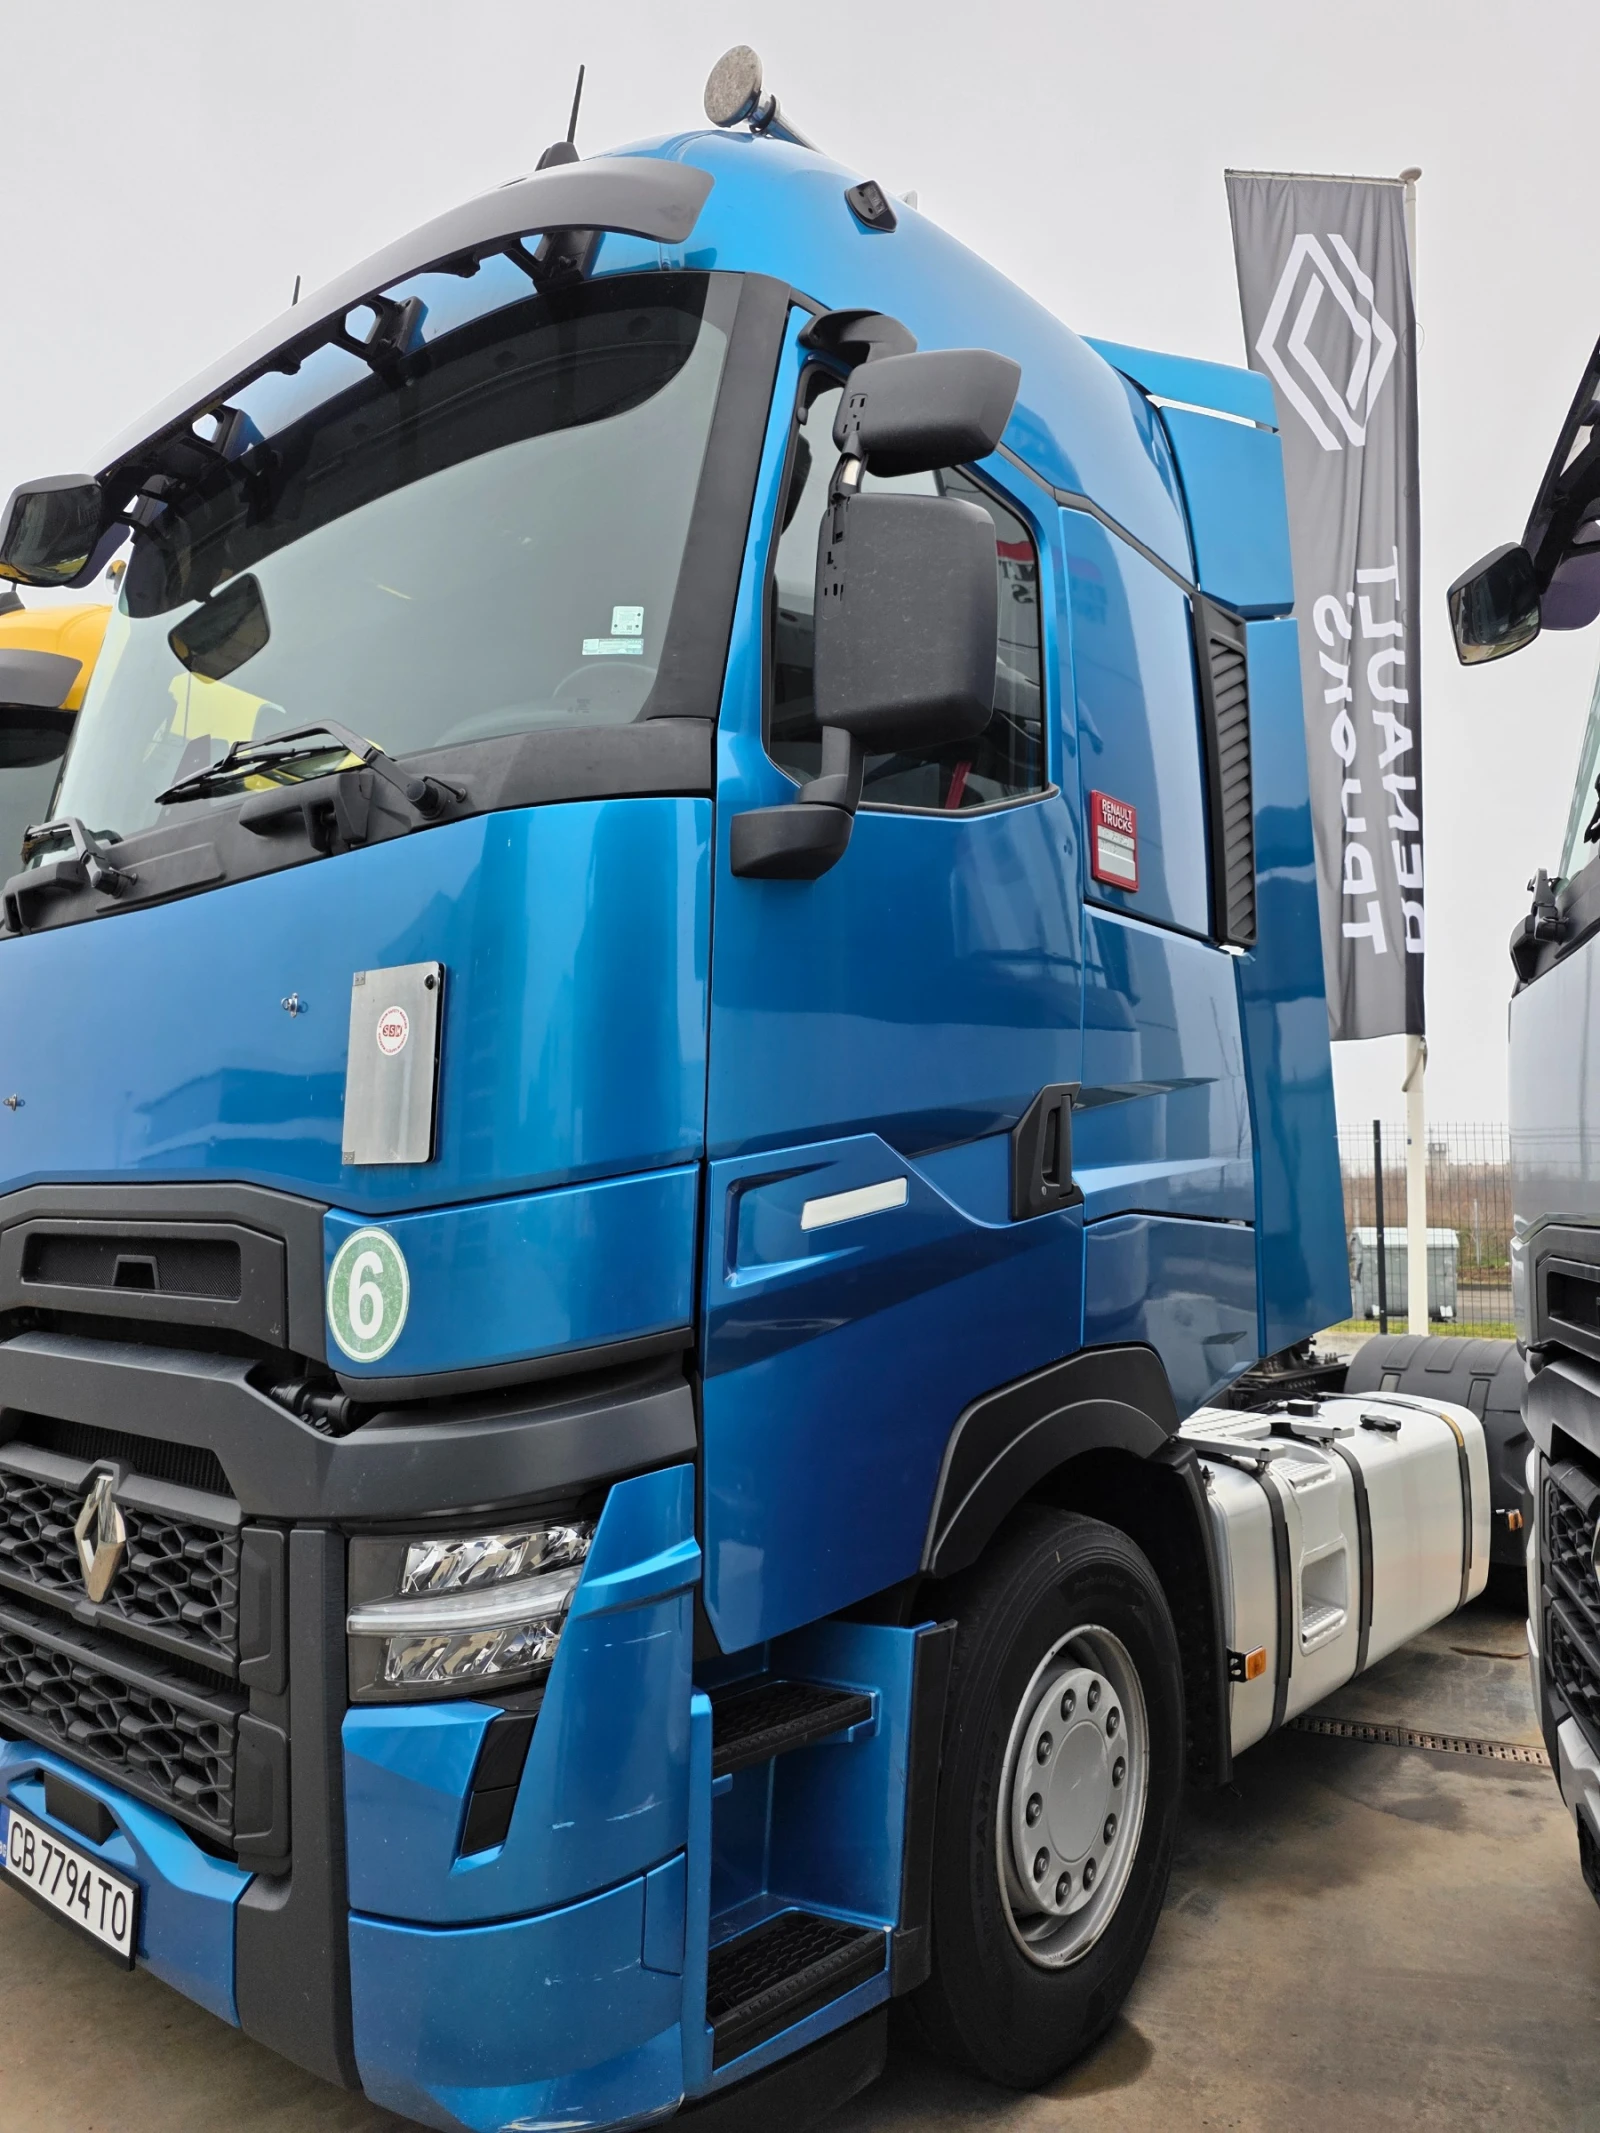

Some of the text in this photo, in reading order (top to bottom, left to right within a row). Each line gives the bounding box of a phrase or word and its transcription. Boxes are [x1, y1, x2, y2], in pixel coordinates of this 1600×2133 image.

[1102, 798, 1133, 819] RENAULT
[1102, 811, 1133, 833] TRUCKS
[348, 1250, 385, 1341] 6
[39, 1839, 92, 1920] 7794
